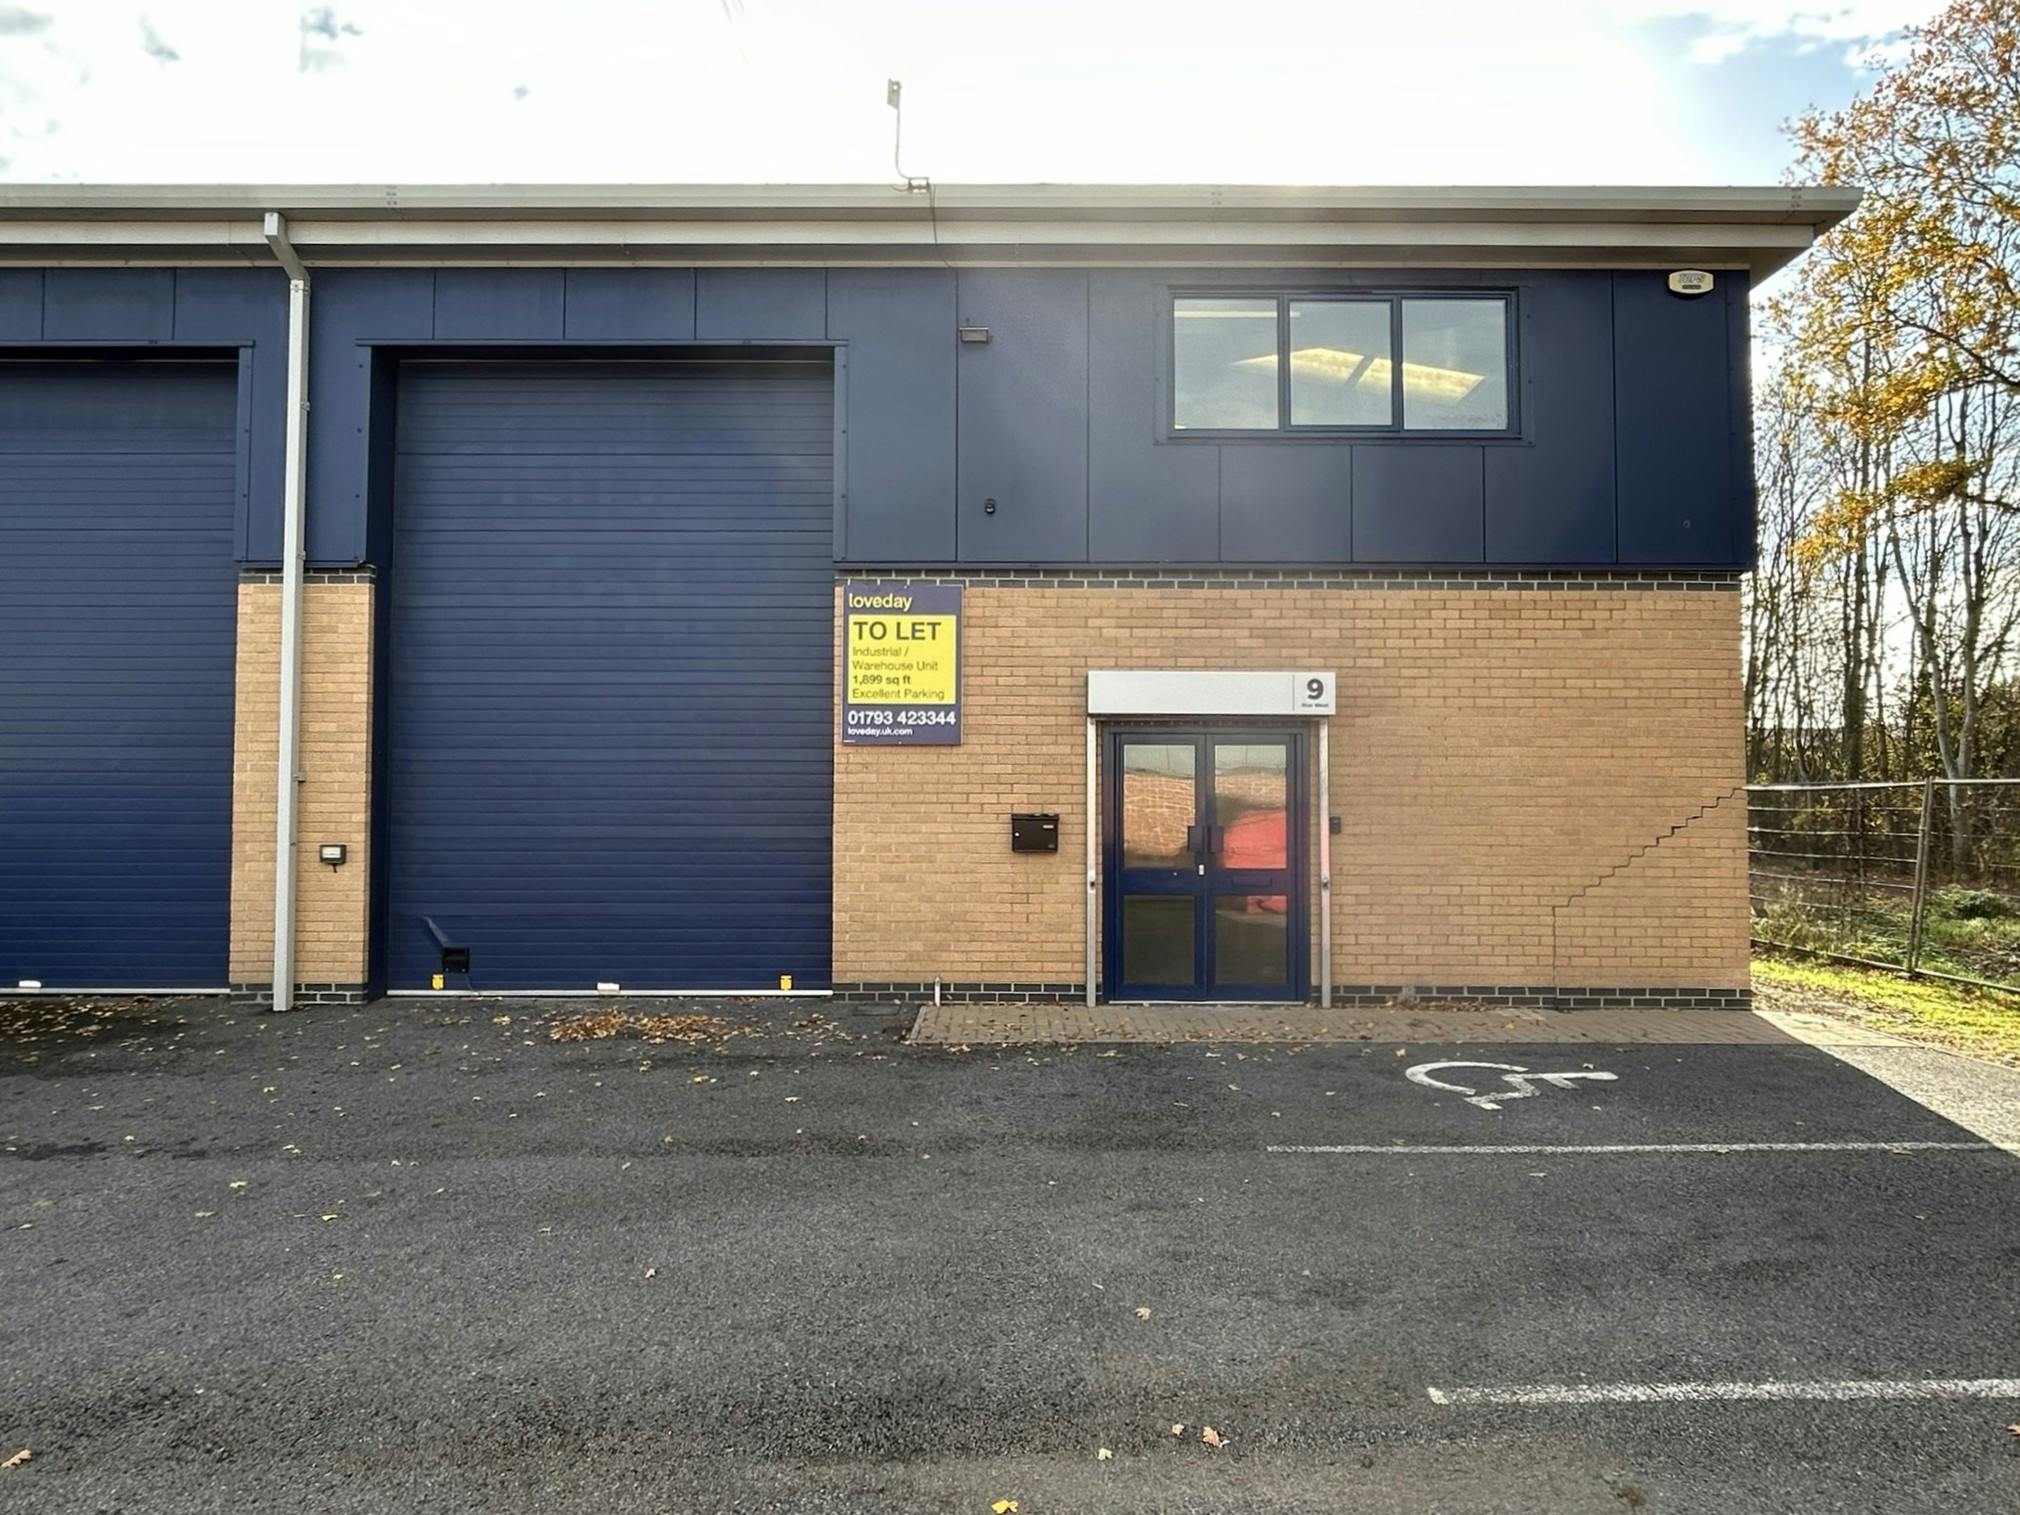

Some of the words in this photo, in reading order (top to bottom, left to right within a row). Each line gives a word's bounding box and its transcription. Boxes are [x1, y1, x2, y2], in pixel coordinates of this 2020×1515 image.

[848, 592, 913, 612] loveday
[852, 621, 887, 641] TO
[896, 621, 942, 641] LET
[852, 646, 902, 657] Industrial
[852, 660, 914, 671] Warehouse
[916, 661, 938, 671] Unit
[885, 676, 900, 686] sq
[902, 675, 911, 684] ft
[852, 688, 900, 698] Excellent
[904, 688, 945, 701] Parking
[1307, 678, 1324, 700] 9
[848, 710, 893, 725] 01793
[897, 710, 956, 725] 423344
[848, 727, 913, 737] loveday.uk.com
